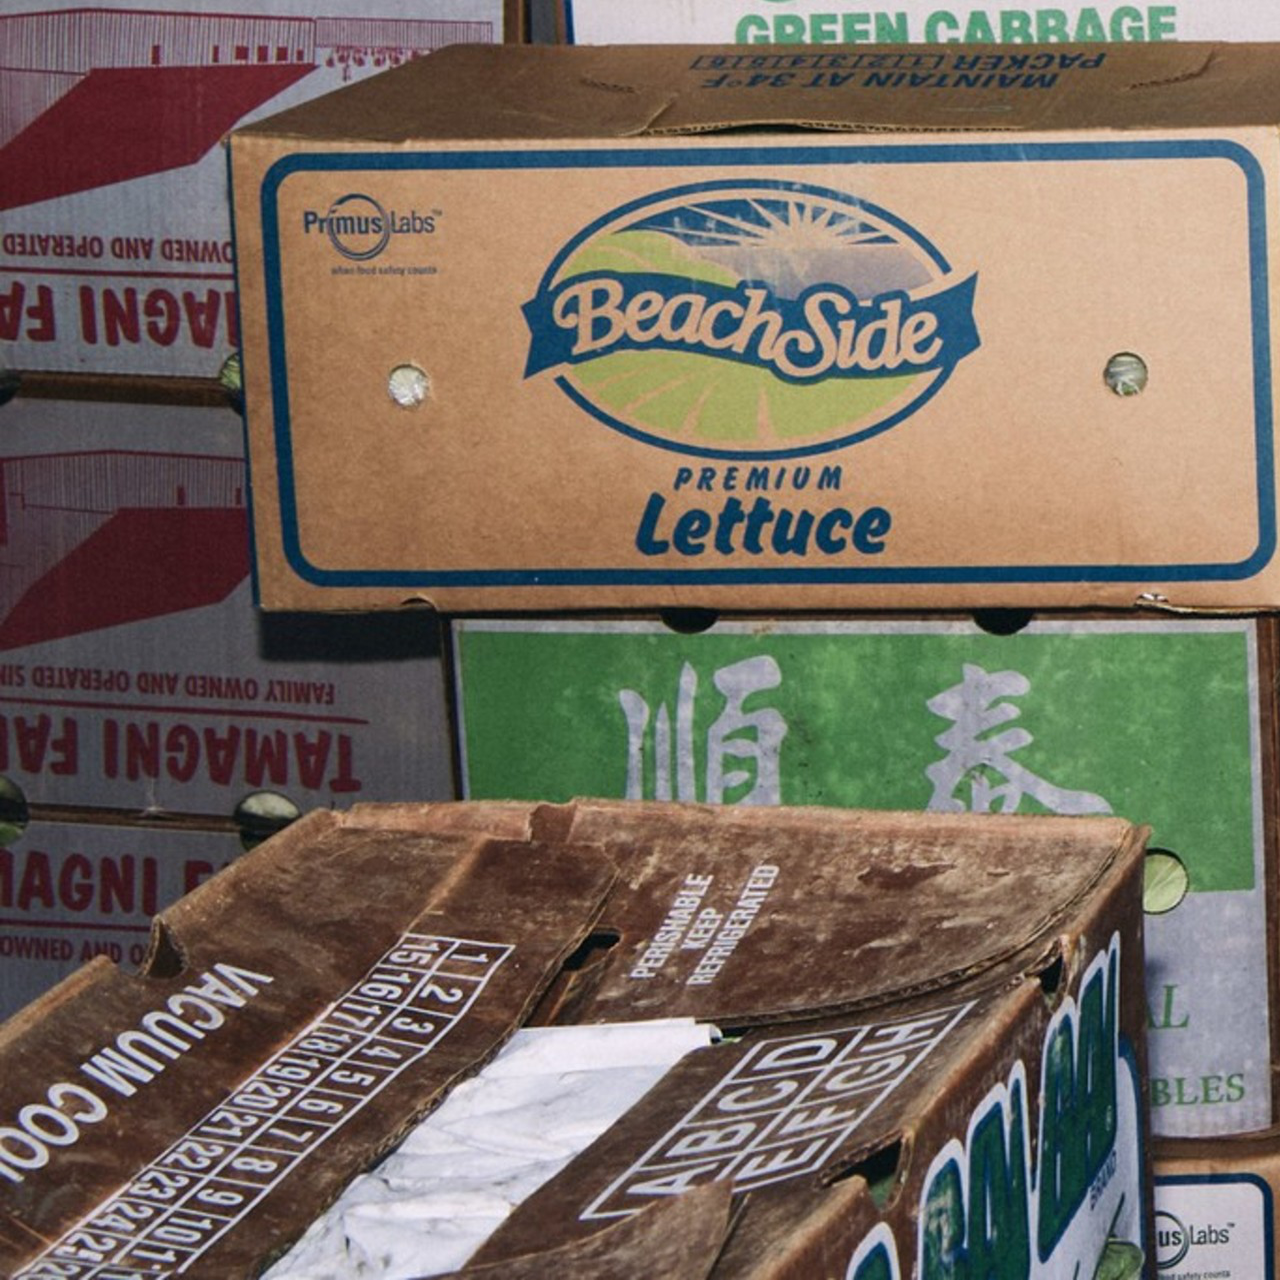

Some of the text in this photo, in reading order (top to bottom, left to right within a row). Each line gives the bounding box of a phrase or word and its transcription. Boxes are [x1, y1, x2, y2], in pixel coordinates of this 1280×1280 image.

[952, 53, 1107, 72] PACKER
[804, 73, 853, 88] AT
[863, 72, 1059, 89] MAINTAIN
[3, 233, 103, 258] OPERATED
[111, 237, 153, 259] AND
[673, 466, 843, 492] PREMIUM
[635, 492, 892, 556] Lettuce
[31, 666, 130, 693] OPERATED
[137, 672, 179, 696] AND
[185, 676, 257, 701] OWNED
[265, 680, 336, 705] FAMILY
[0, 713, 363, 793] TAMAGNI FA
[630, 873, 714, 979] PERISHABLE
[681, 907, 724, 950] KEEP
[686, 864, 780, 986] REFRIGERATED
[1, 935, 74, 961] OWNED
[389, 942, 440, 965] 15
[451, 953, 489, 963] 1
[359, 972, 412, 1000] 16
[420, 983, 463, 1003] 2
[331, 1002, 382, 1029] 17
[1149, 984, 1190, 1029] L
[392, 1017, 435, 1034] 3
[299, 1031, 350, 1054] 18
[361, 1043, 402, 1060] 4
[0, 962, 275, 1183] VACUUM COO
[266, 1056, 320, 1081] 19
[331, 1070, 375, 1087] 5
[233, 1080, 291, 1109] 20
[298, 1098, 343, 1115] 6
[733, 1013, 950, 1181] E F G H
[200, 1110, 258, 1137] 21
[626, 1038, 838, 1195] A B C D
[268, 1127, 314, 1144] 7
[163, 1140, 225, 1169] 22
[231, 1156, 278, 1173] 8
[129, 1170, 189, 1200] 23
[197, 1188, 244, 1206] 9
[91, 1201, 154, 1233] 24
[153, 1218, 214, 1244] 10
[54, 1232, 117, 1262] 25
